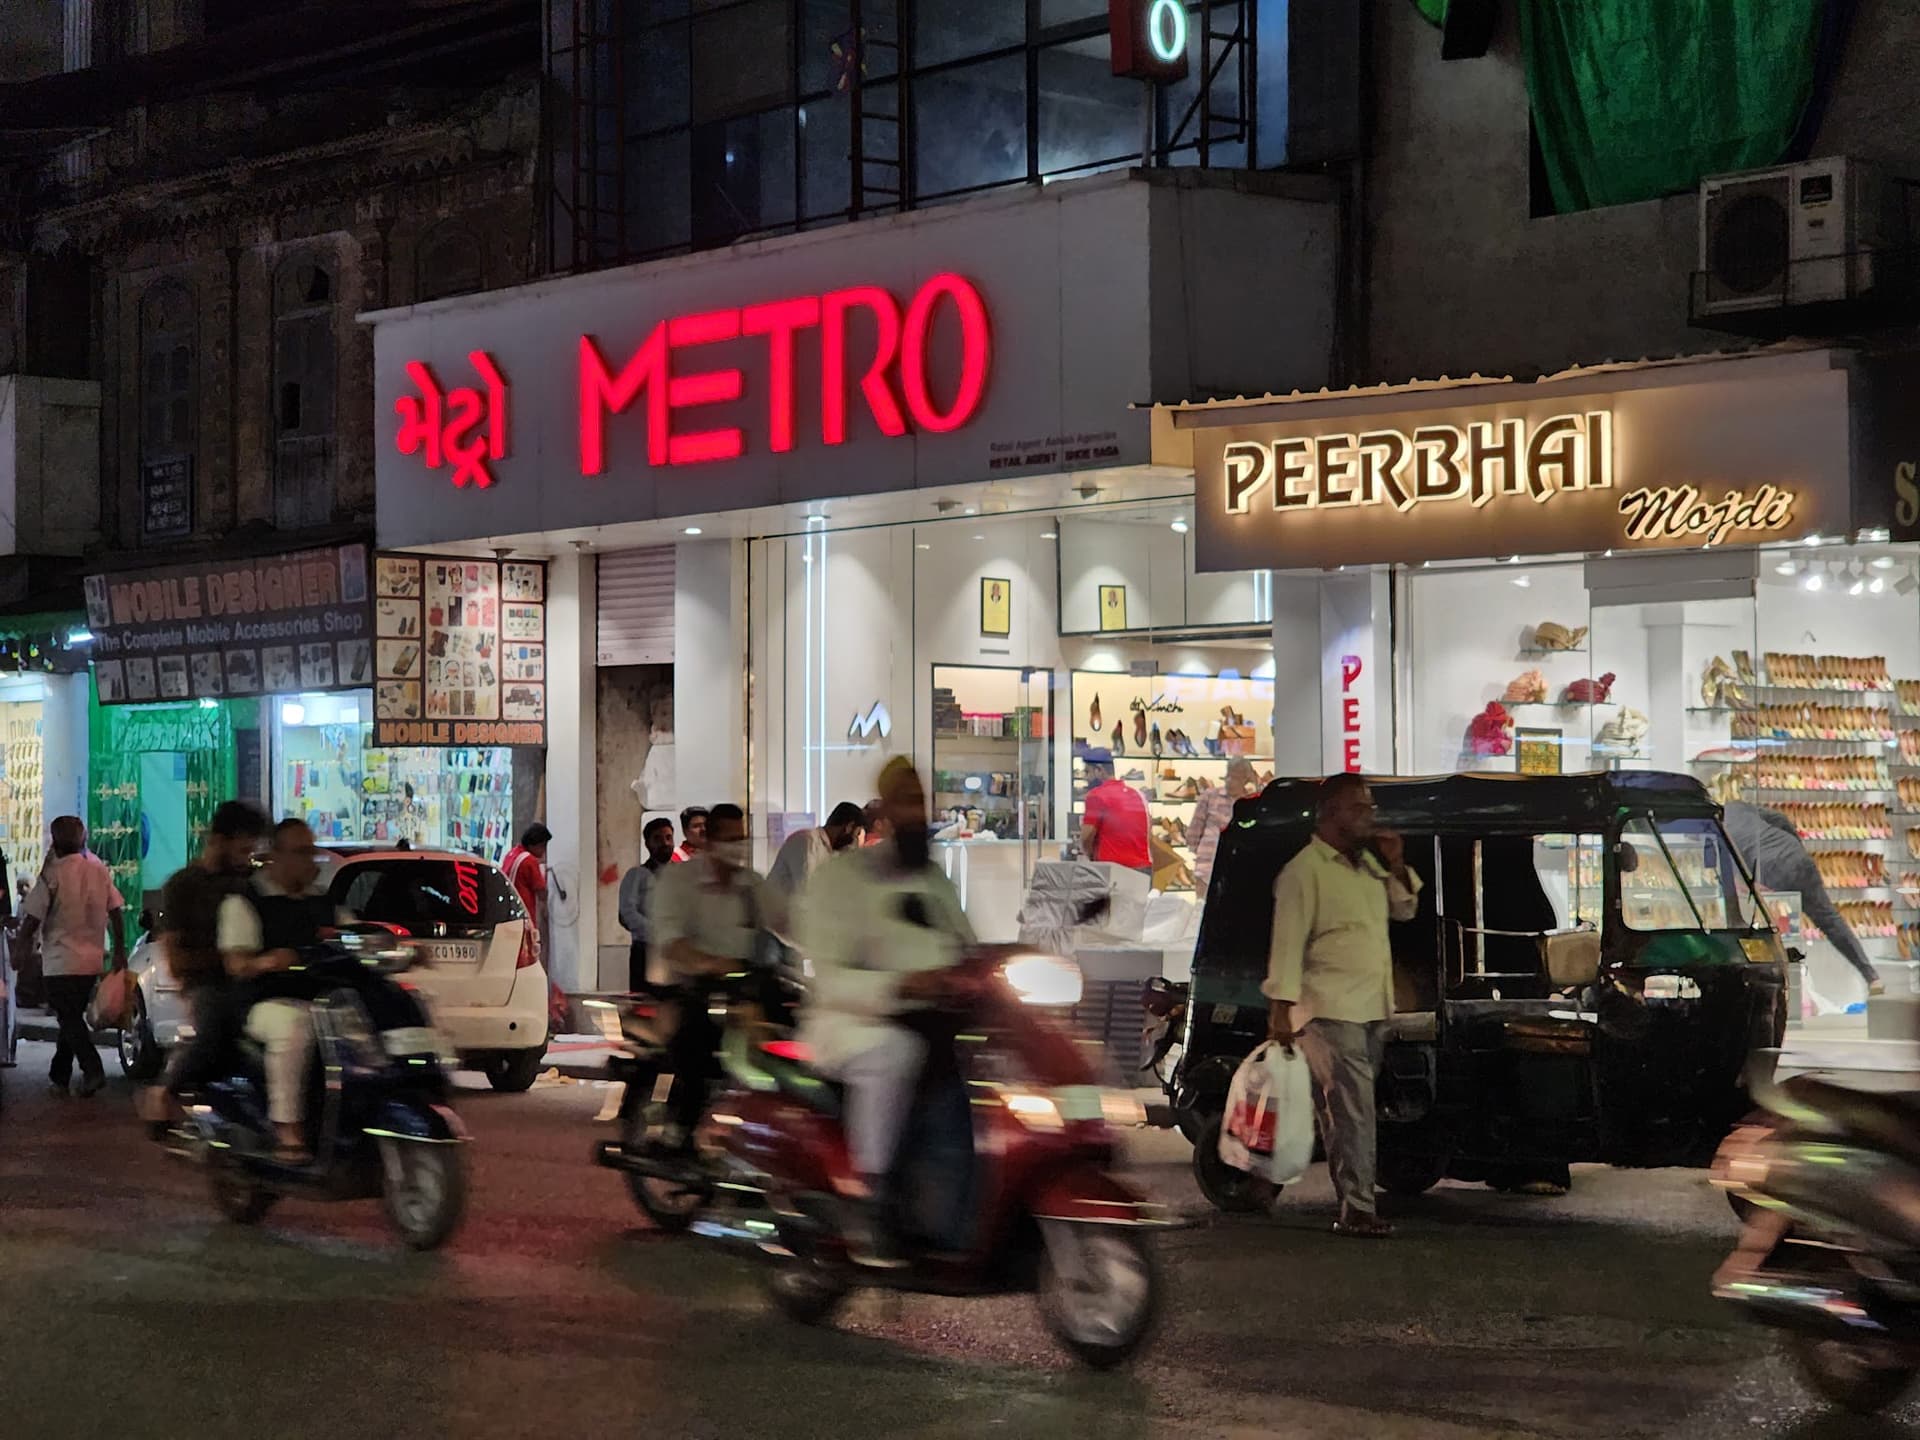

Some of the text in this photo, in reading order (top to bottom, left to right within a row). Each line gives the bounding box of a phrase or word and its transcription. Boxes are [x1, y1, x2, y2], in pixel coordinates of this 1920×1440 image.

[579, 272, 988, 475] METRO
[395, 349, 506, 489] મેટ્રો
[1224, 410, 1613, 514] PEERBHAI
[1619, 483, 1795, 545] Mojdi
[110, 562, 338, 624] MOBILE DESIGNER
[99, 612, 362, 650] The Complete Mobile Accessories Shop
[379, 723, 544, 745] MOBILE DESIGNER
